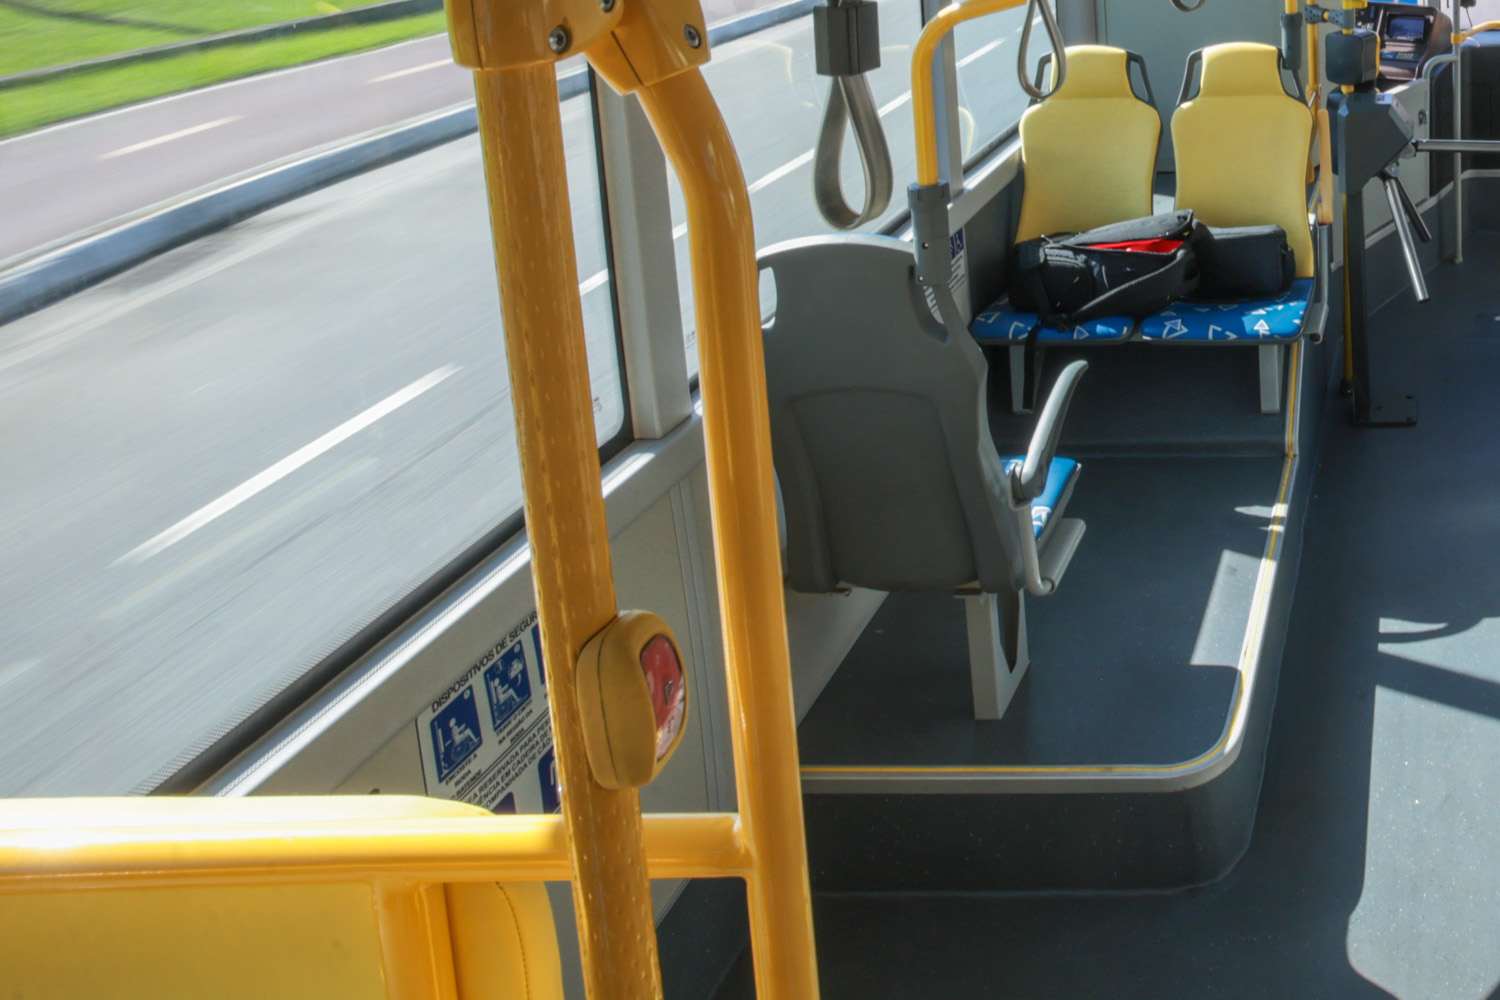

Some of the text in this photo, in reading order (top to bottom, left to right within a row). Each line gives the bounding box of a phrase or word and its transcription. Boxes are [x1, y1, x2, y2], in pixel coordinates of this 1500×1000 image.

[431, 650, 495, 714] DISPOSITIVOS
[495, 637, 508, 655] DE
[454, 769, 472, 787] RODA
[478, 751, 520, 794] RESERVADA
[520, 732, 537, 752] PARA
[501, 768, 511, 784] EM
[511, 740, 540, 771] CADEIRA
[541, 730, 548, 742] DE
[528, 754, 537, 765] DE
